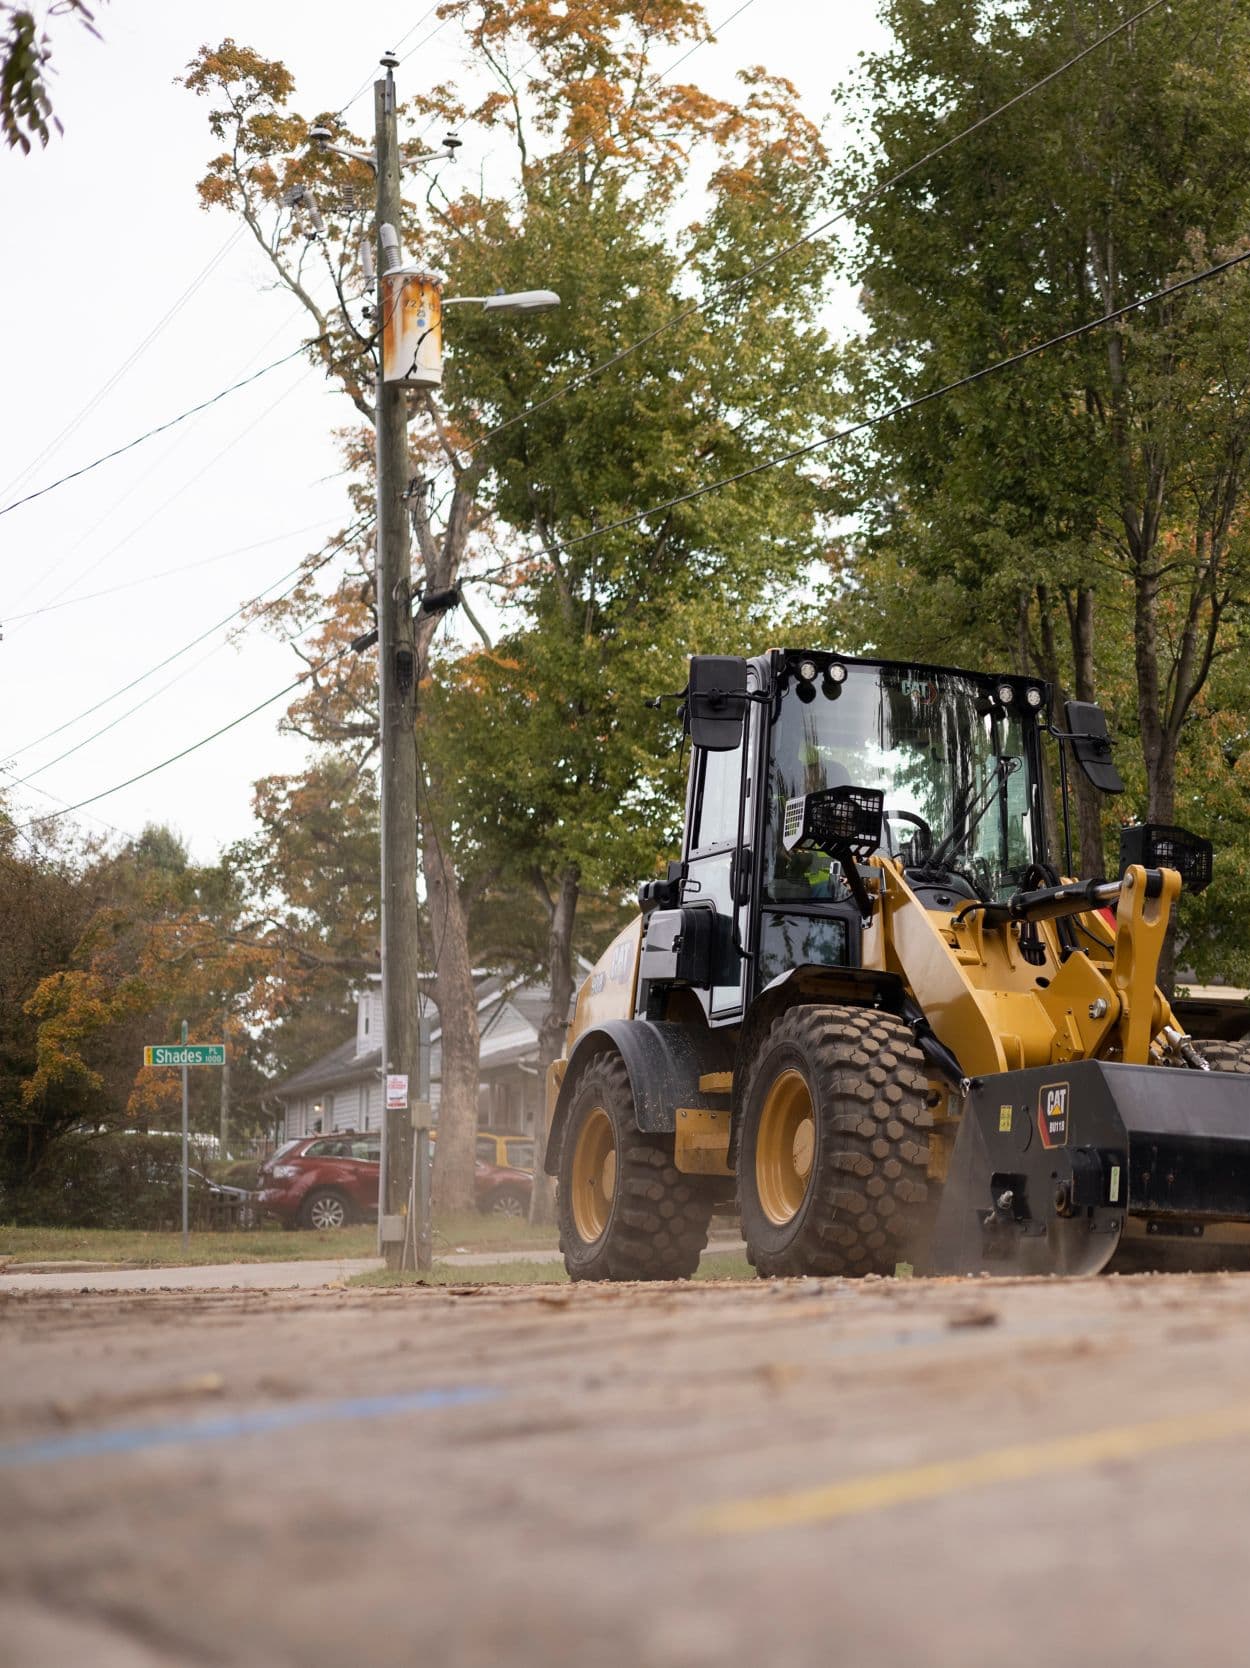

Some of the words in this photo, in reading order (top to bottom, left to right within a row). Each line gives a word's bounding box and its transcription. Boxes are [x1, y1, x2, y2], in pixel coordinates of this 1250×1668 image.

[901, 680, 929, 698] CAT
[155, 1048, 202, 1064] Shades
[1047, 1089, 1067, 1117] CAT
